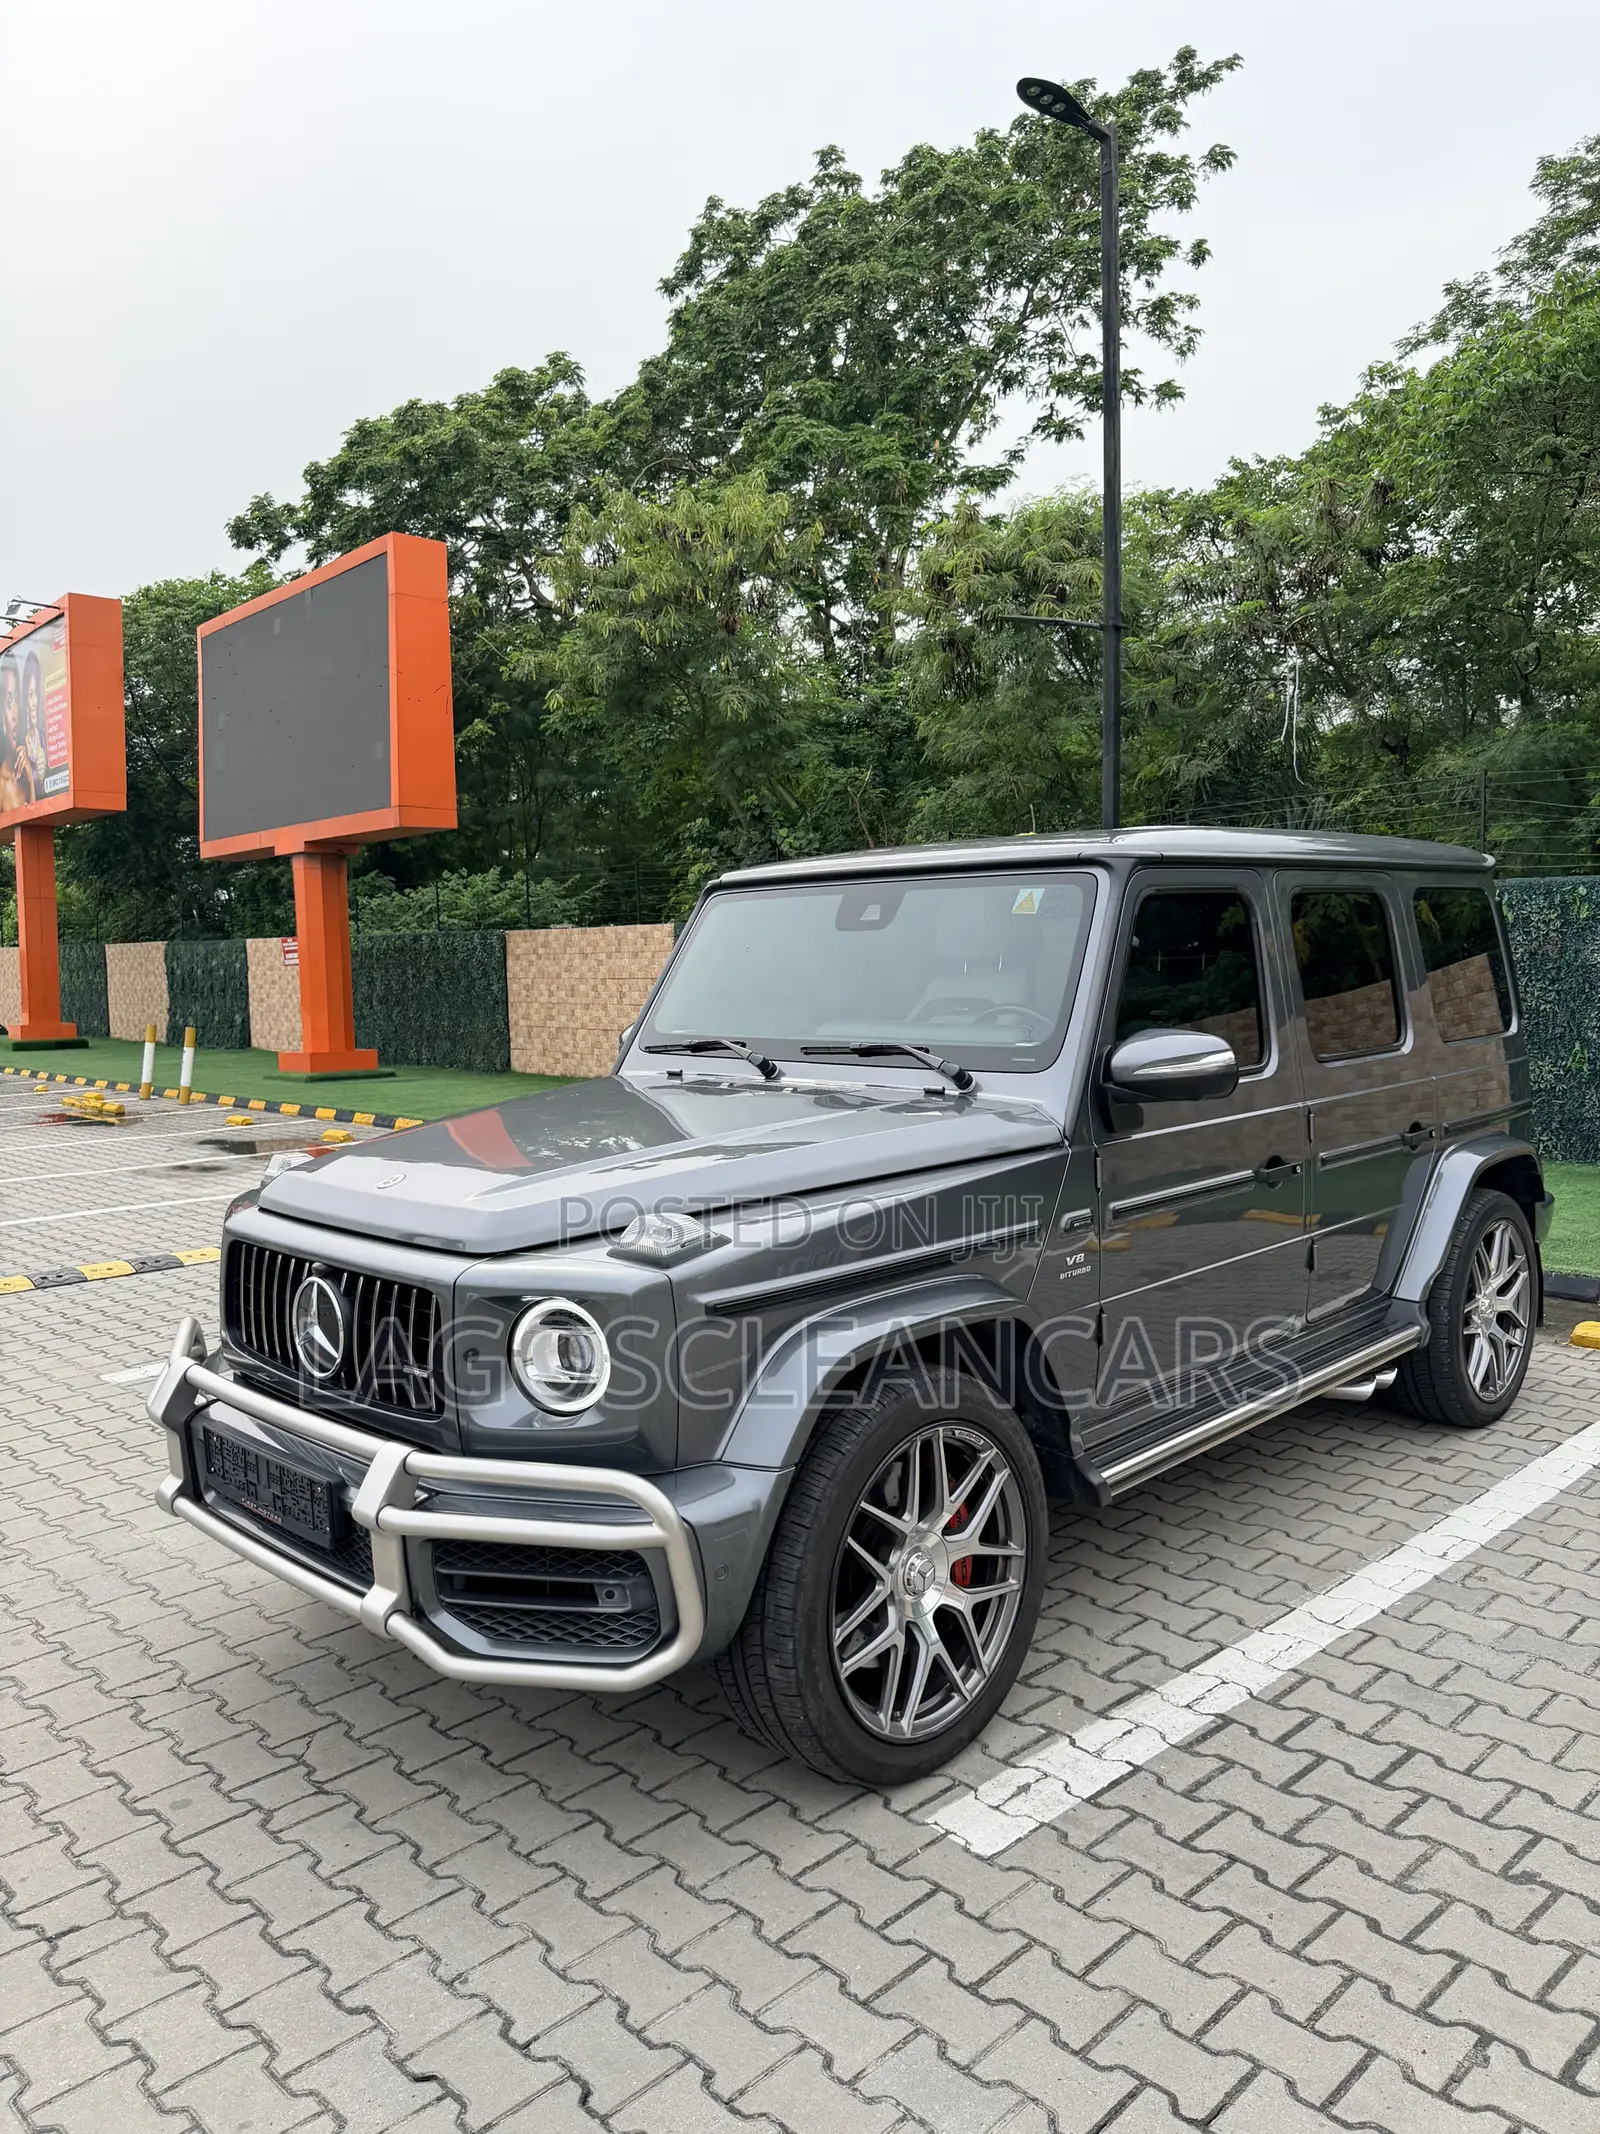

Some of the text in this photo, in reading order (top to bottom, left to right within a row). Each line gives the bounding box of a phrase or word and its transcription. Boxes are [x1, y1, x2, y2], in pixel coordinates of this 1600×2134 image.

[1066, 1253, 1084, 1265] V8
[1060, 1266, 1091, 1279] BITURBO
[258, 1507, 282, 1522] MOTORS
